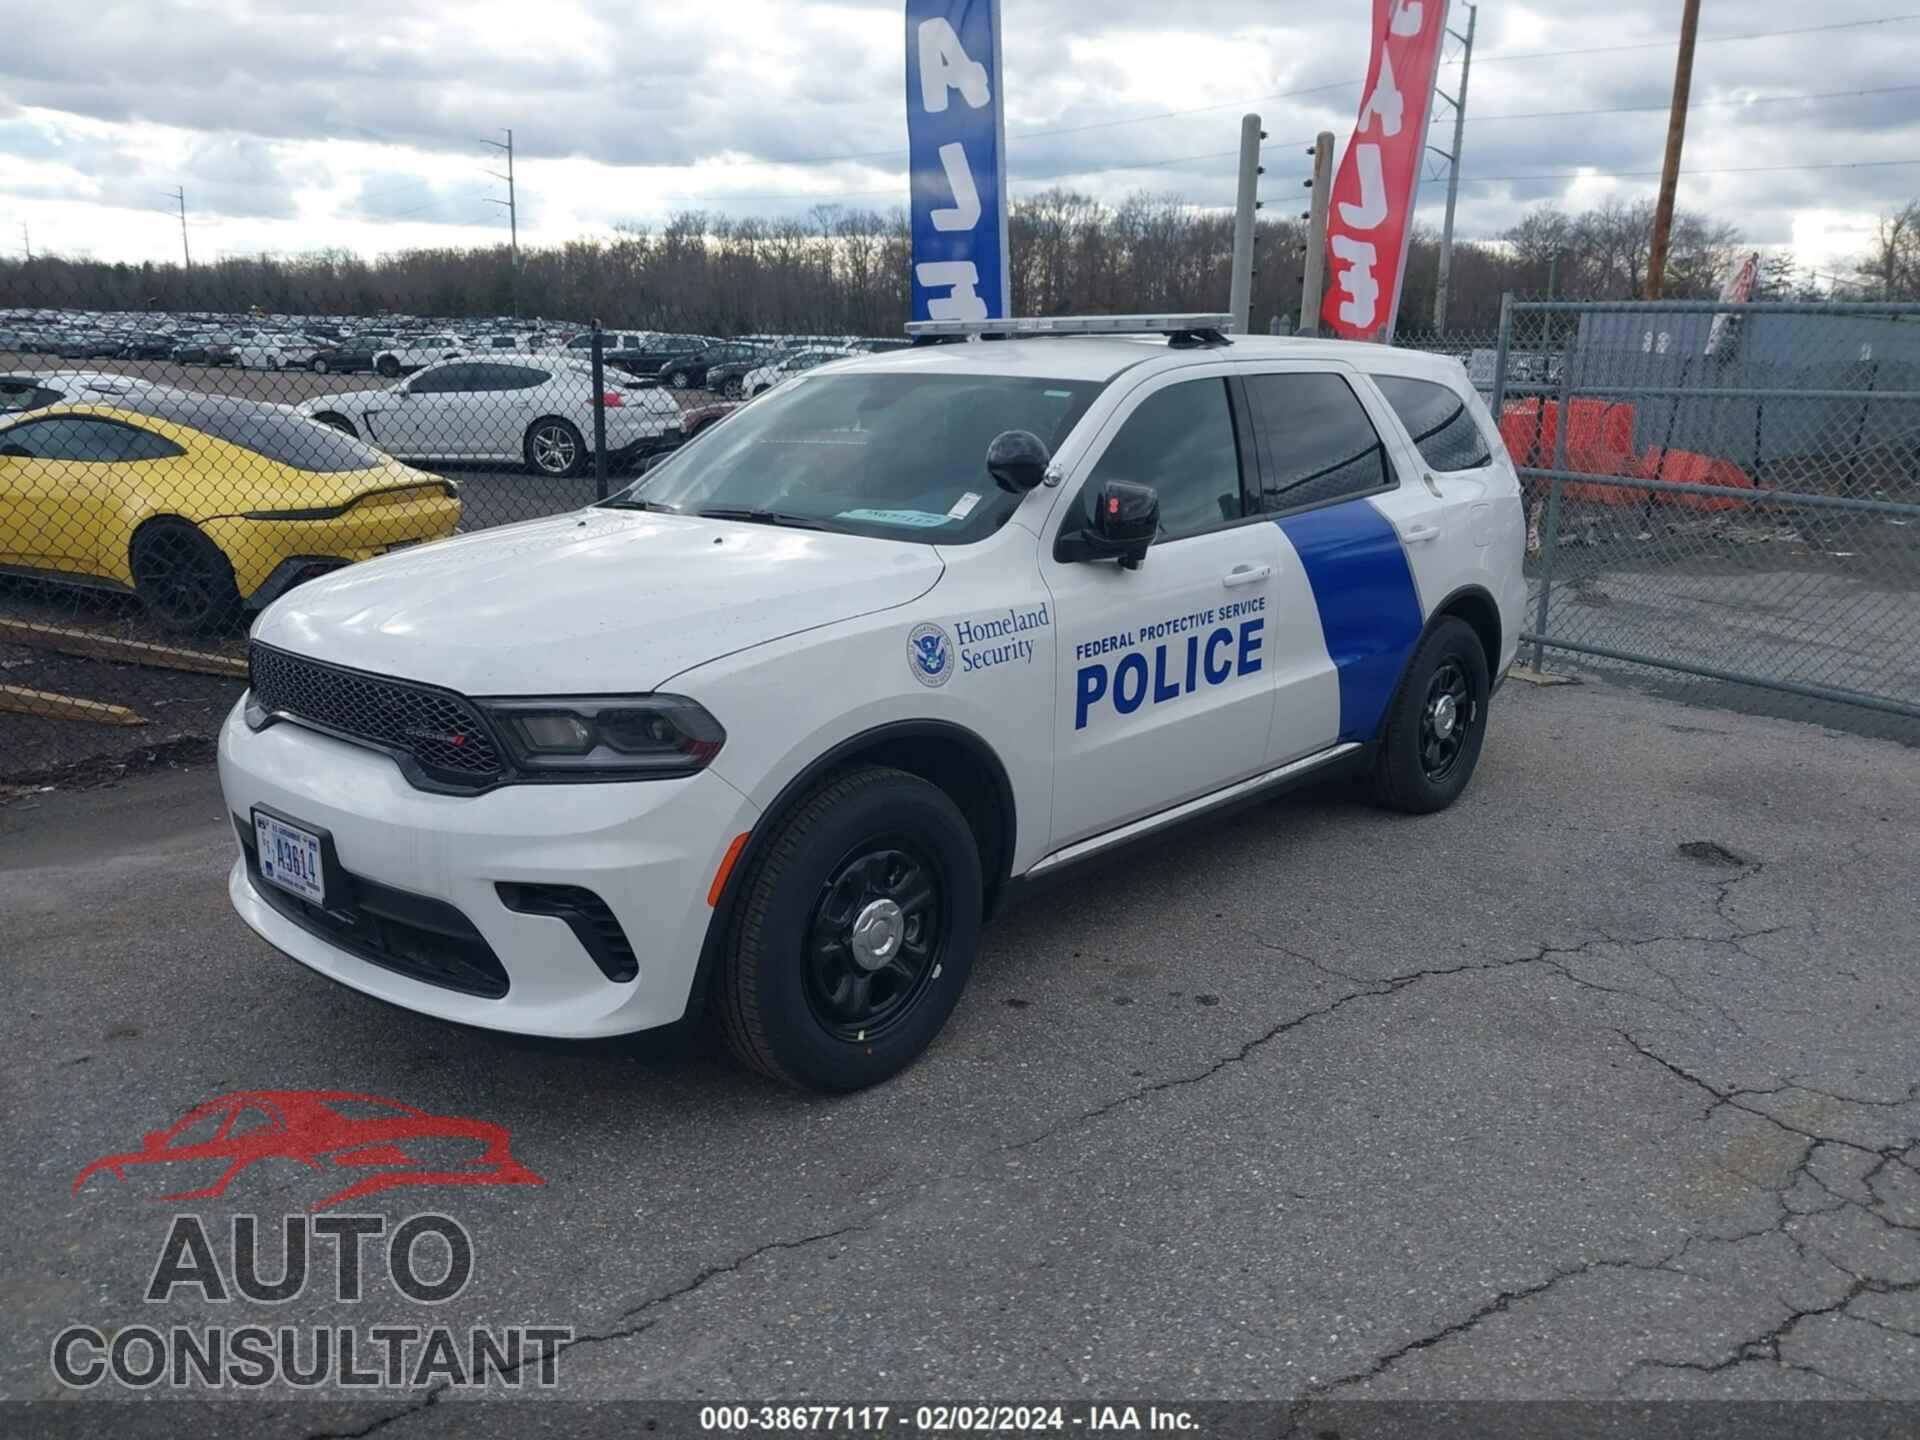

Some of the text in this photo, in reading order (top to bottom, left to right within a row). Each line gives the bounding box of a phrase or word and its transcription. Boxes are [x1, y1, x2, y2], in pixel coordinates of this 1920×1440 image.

[954, 602, 1050, 646] Homeland
[1076, 597, 1265, 660] FEDERAL PROTECTIVE SERVICE
[961, 637, 1035, 673] Security
[1075, 617, 1265, 731] POLICE
